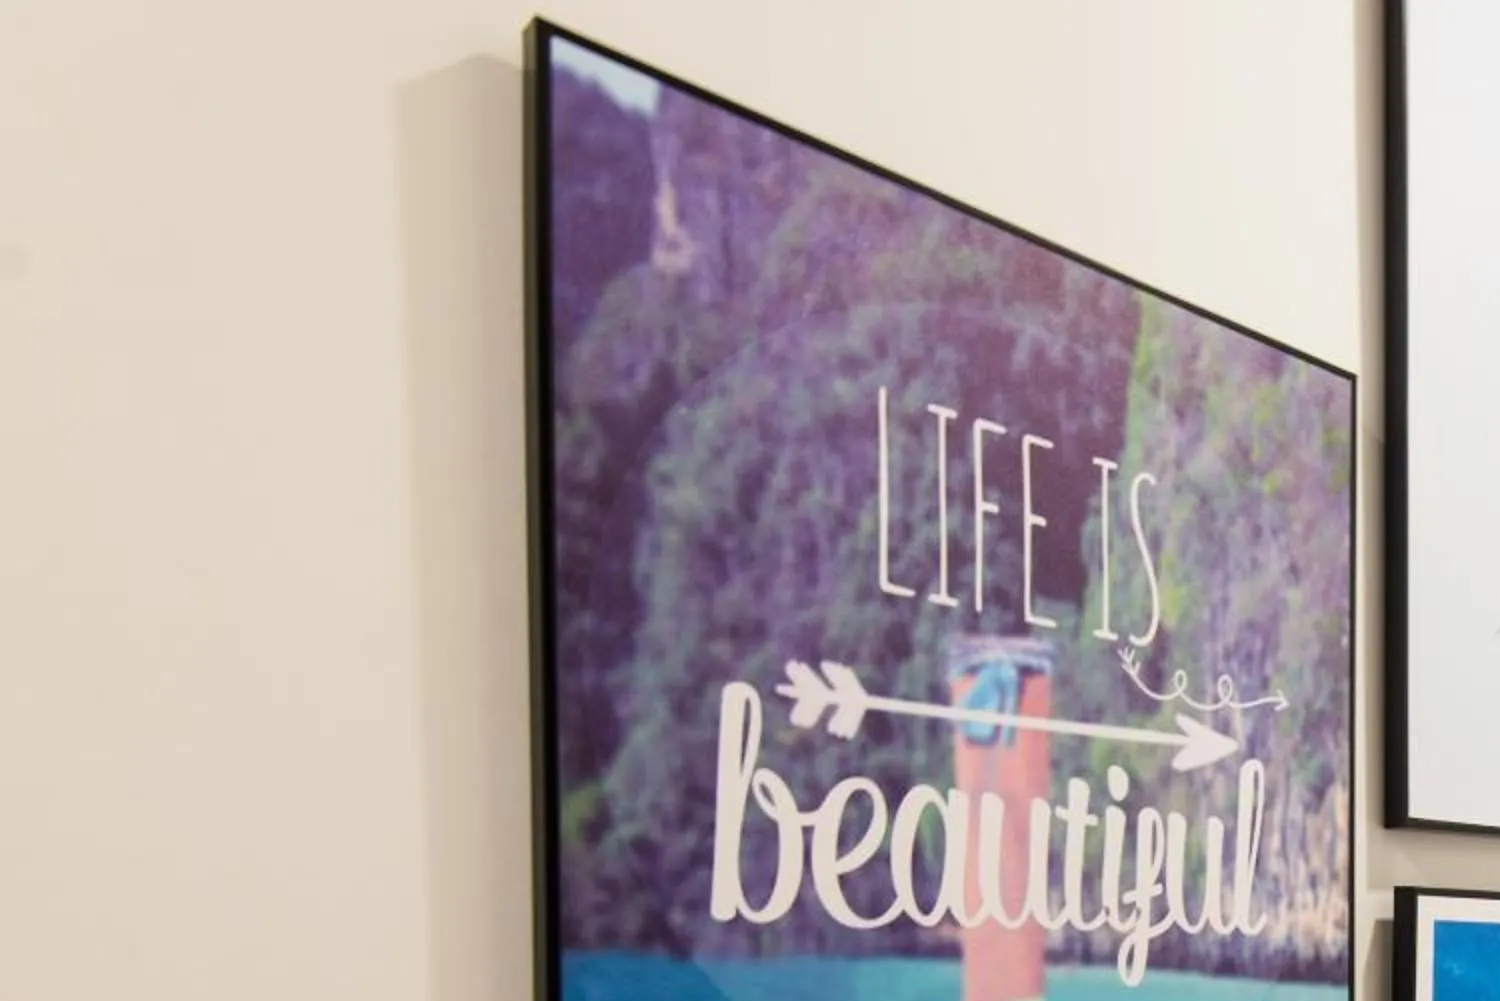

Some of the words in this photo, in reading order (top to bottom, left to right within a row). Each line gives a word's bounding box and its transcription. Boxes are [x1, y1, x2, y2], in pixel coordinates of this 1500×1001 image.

[878, 386, 1057, 628] LIFE
[1092, 457, 1160, 646] IS
[709, 681, 1269, 987] beautiful
